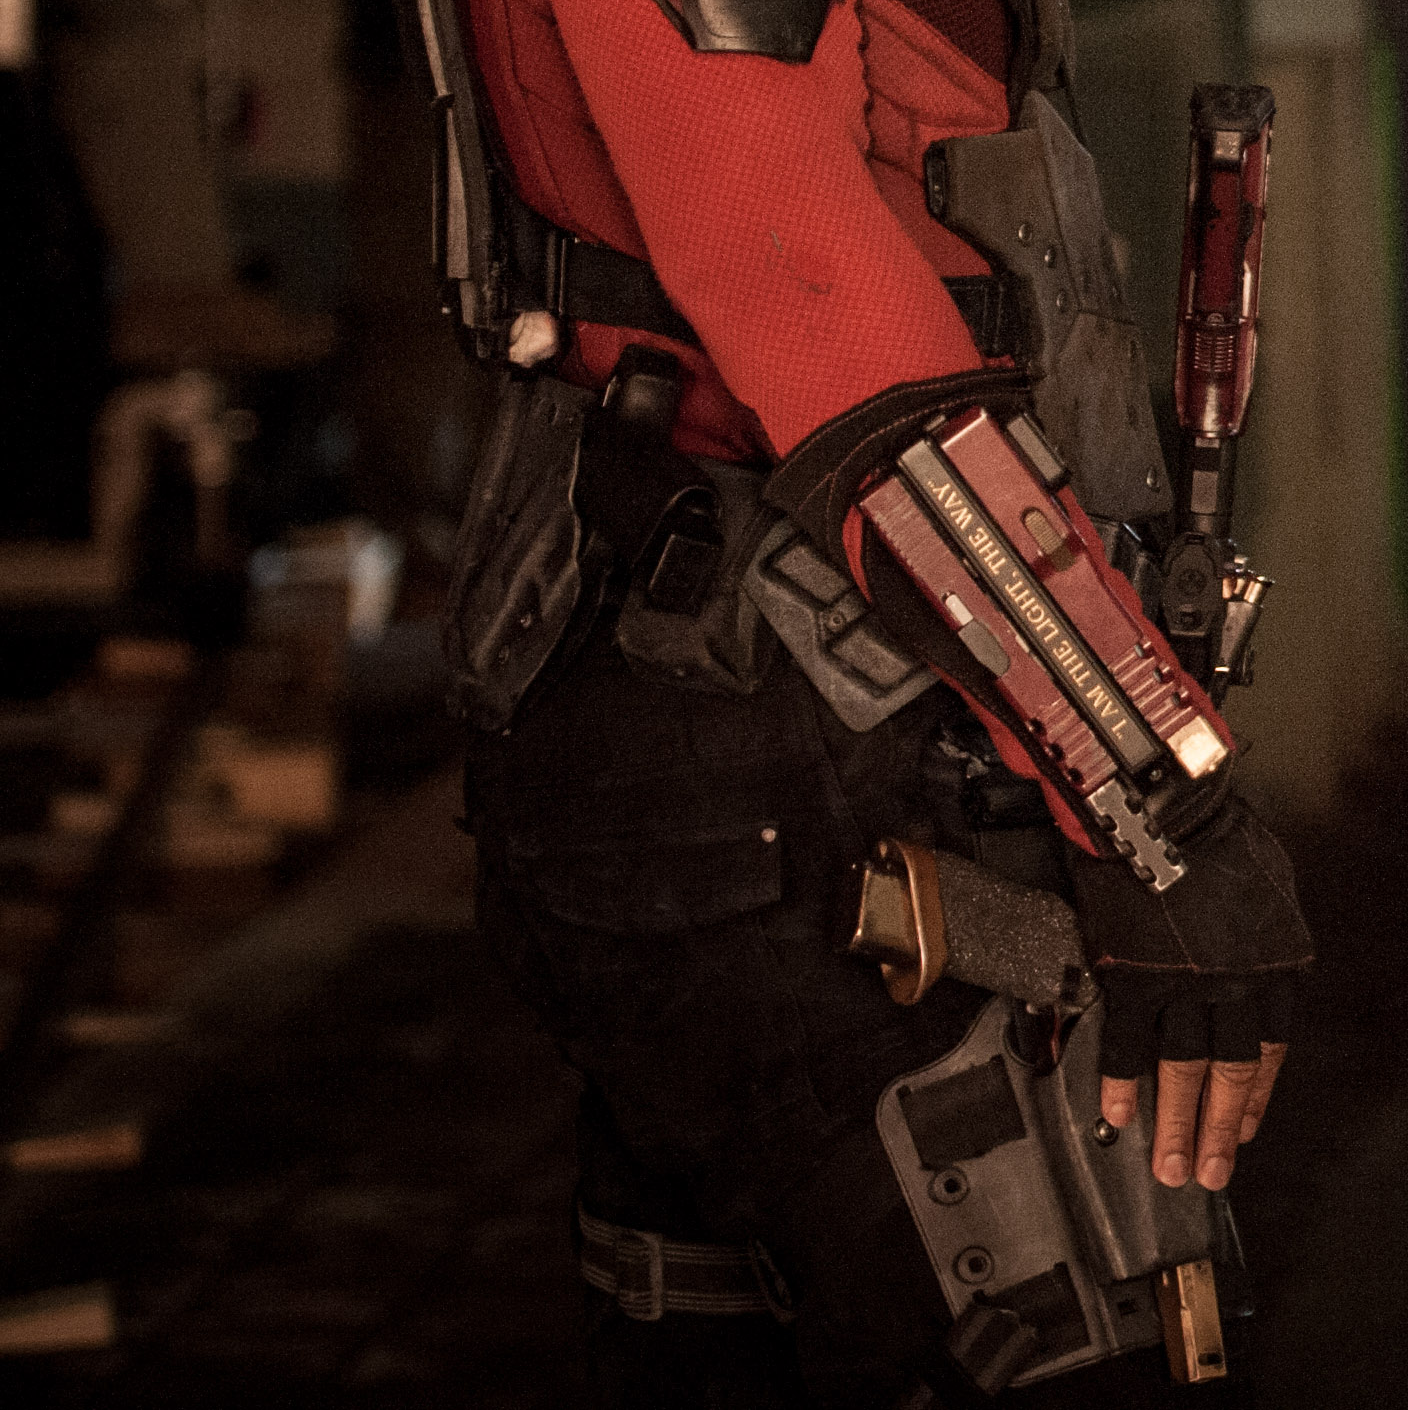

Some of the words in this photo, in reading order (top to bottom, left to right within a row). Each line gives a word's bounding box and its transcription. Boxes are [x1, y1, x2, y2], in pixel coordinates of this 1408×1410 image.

[968, 527, 1007, 574] THE
[1052, 640, 1090, 687] THE
[1085, 684, 1119, 718] AM
